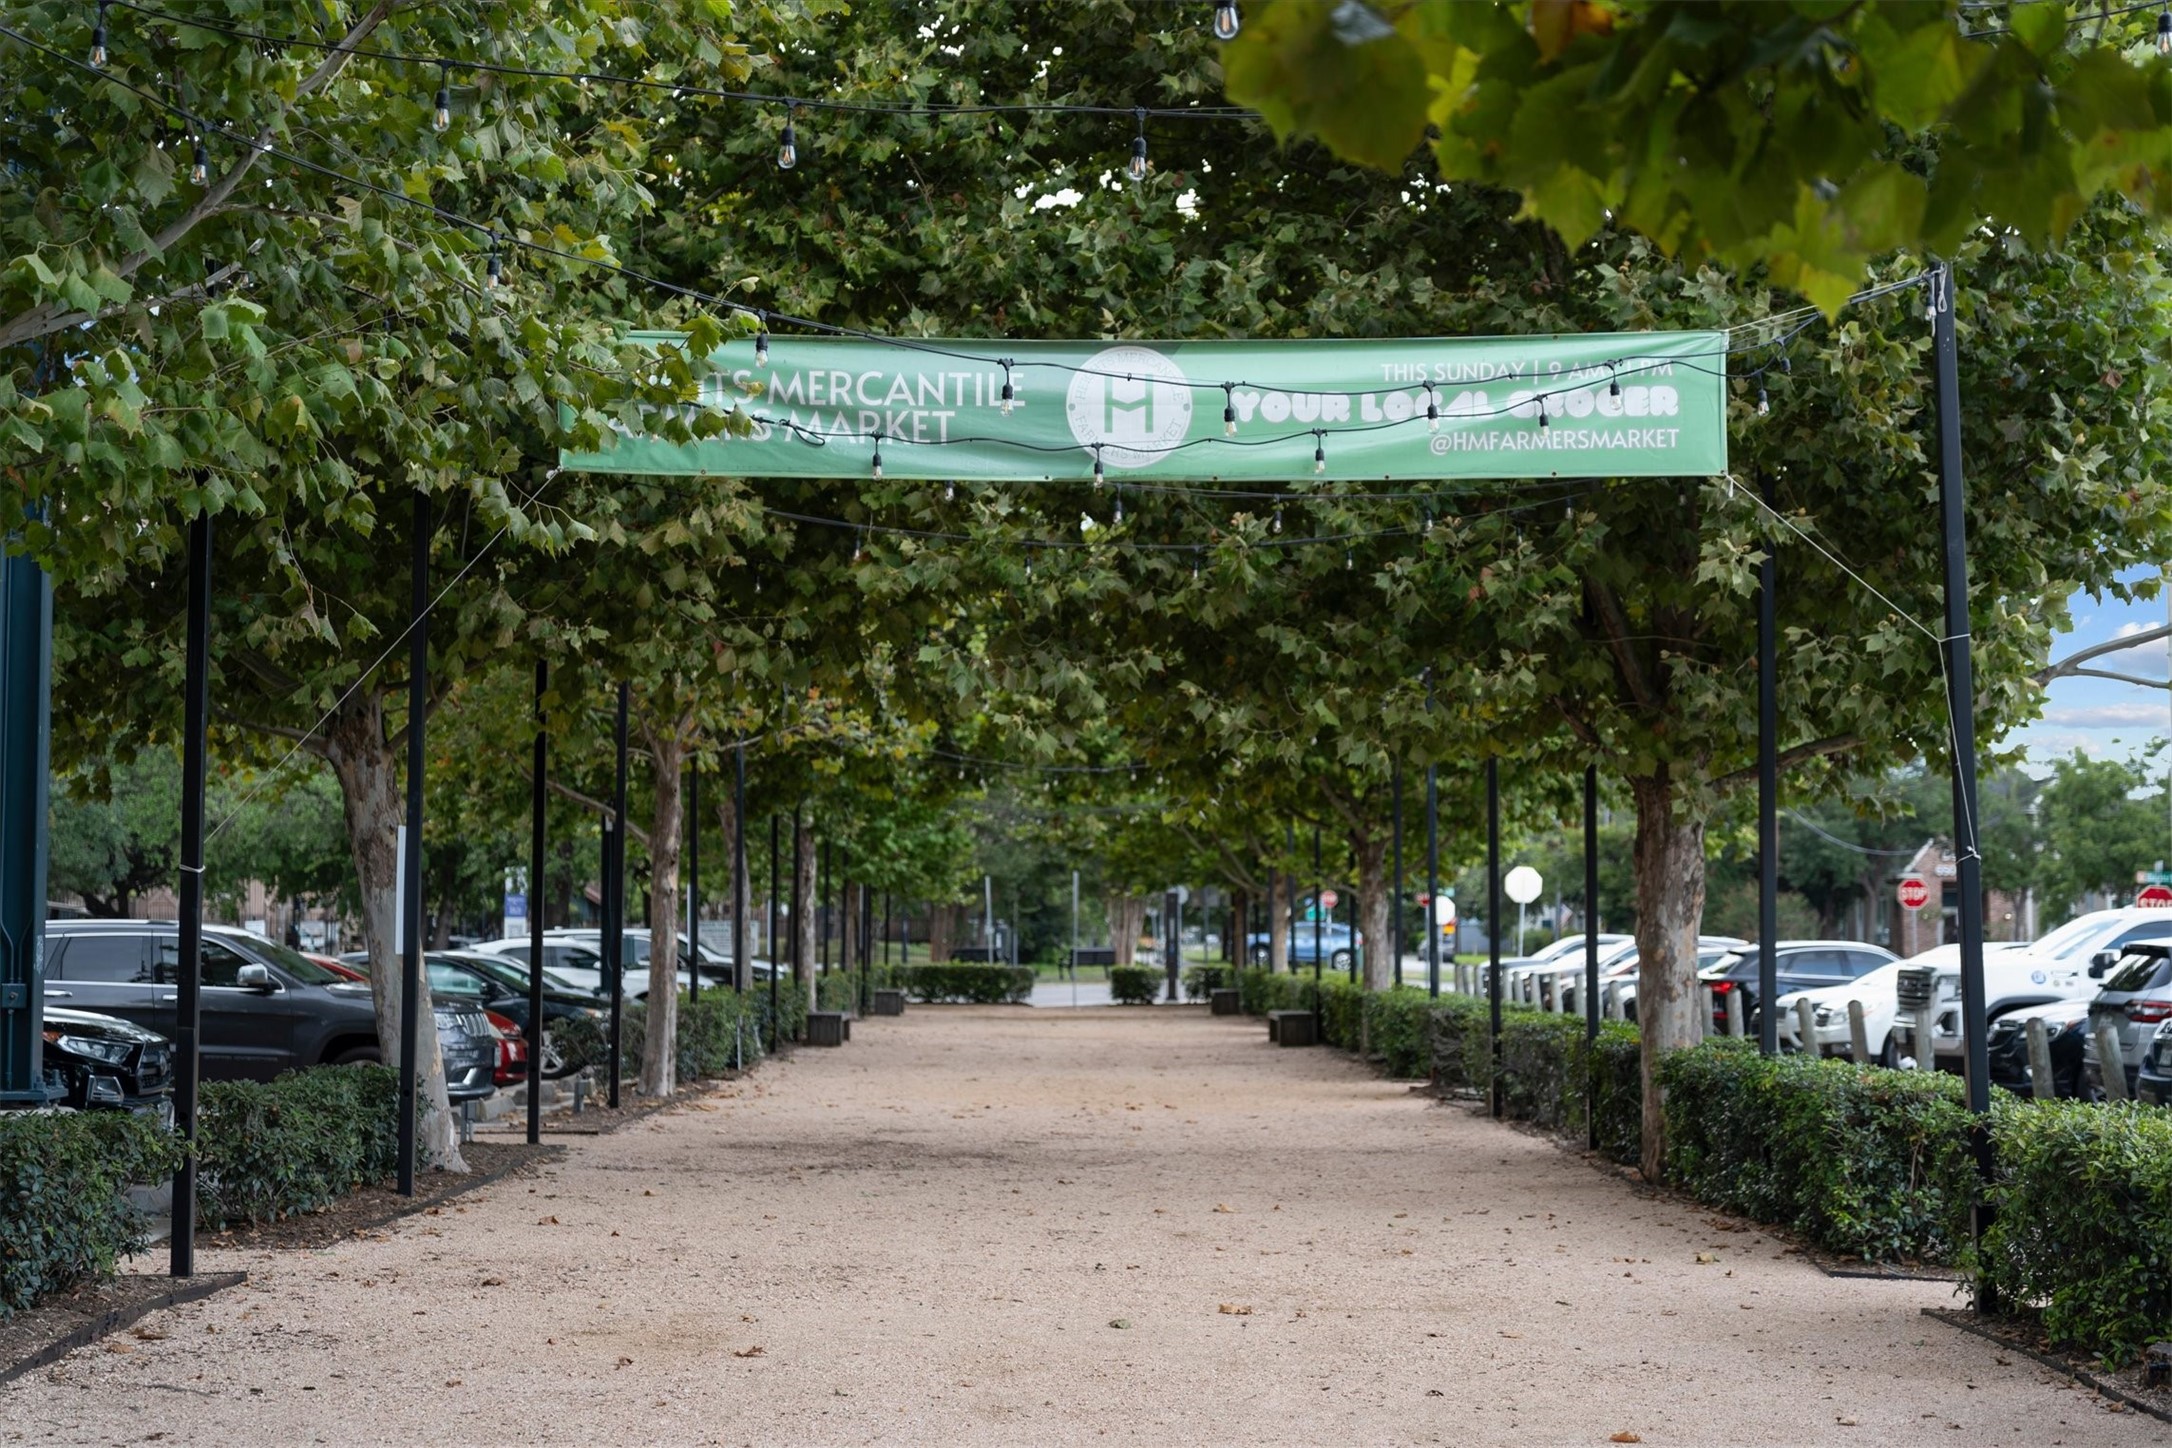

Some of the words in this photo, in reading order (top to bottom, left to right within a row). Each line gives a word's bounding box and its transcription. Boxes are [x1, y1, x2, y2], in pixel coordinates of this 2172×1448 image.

[1381, 363, 1428, 381] THIS
[1434, 361, 1526, 381] SUNDAY
[1549, 361, 1562, 381] 9
[1640, 358, 1673, 377] PM
[768, 371, 1025, 407] MERCANTILE
[1231, 391, 1350, 423] YOUR
[1361, 390, 1495, 422] LOCAL
[1506, 385, 1679, 418] GROCER
[785, 409, 955, 446] MARKET
[1430, 429, 1680, 455] @HMFARMERSMARKET
[1901, 886, 1928, 901] STOP
